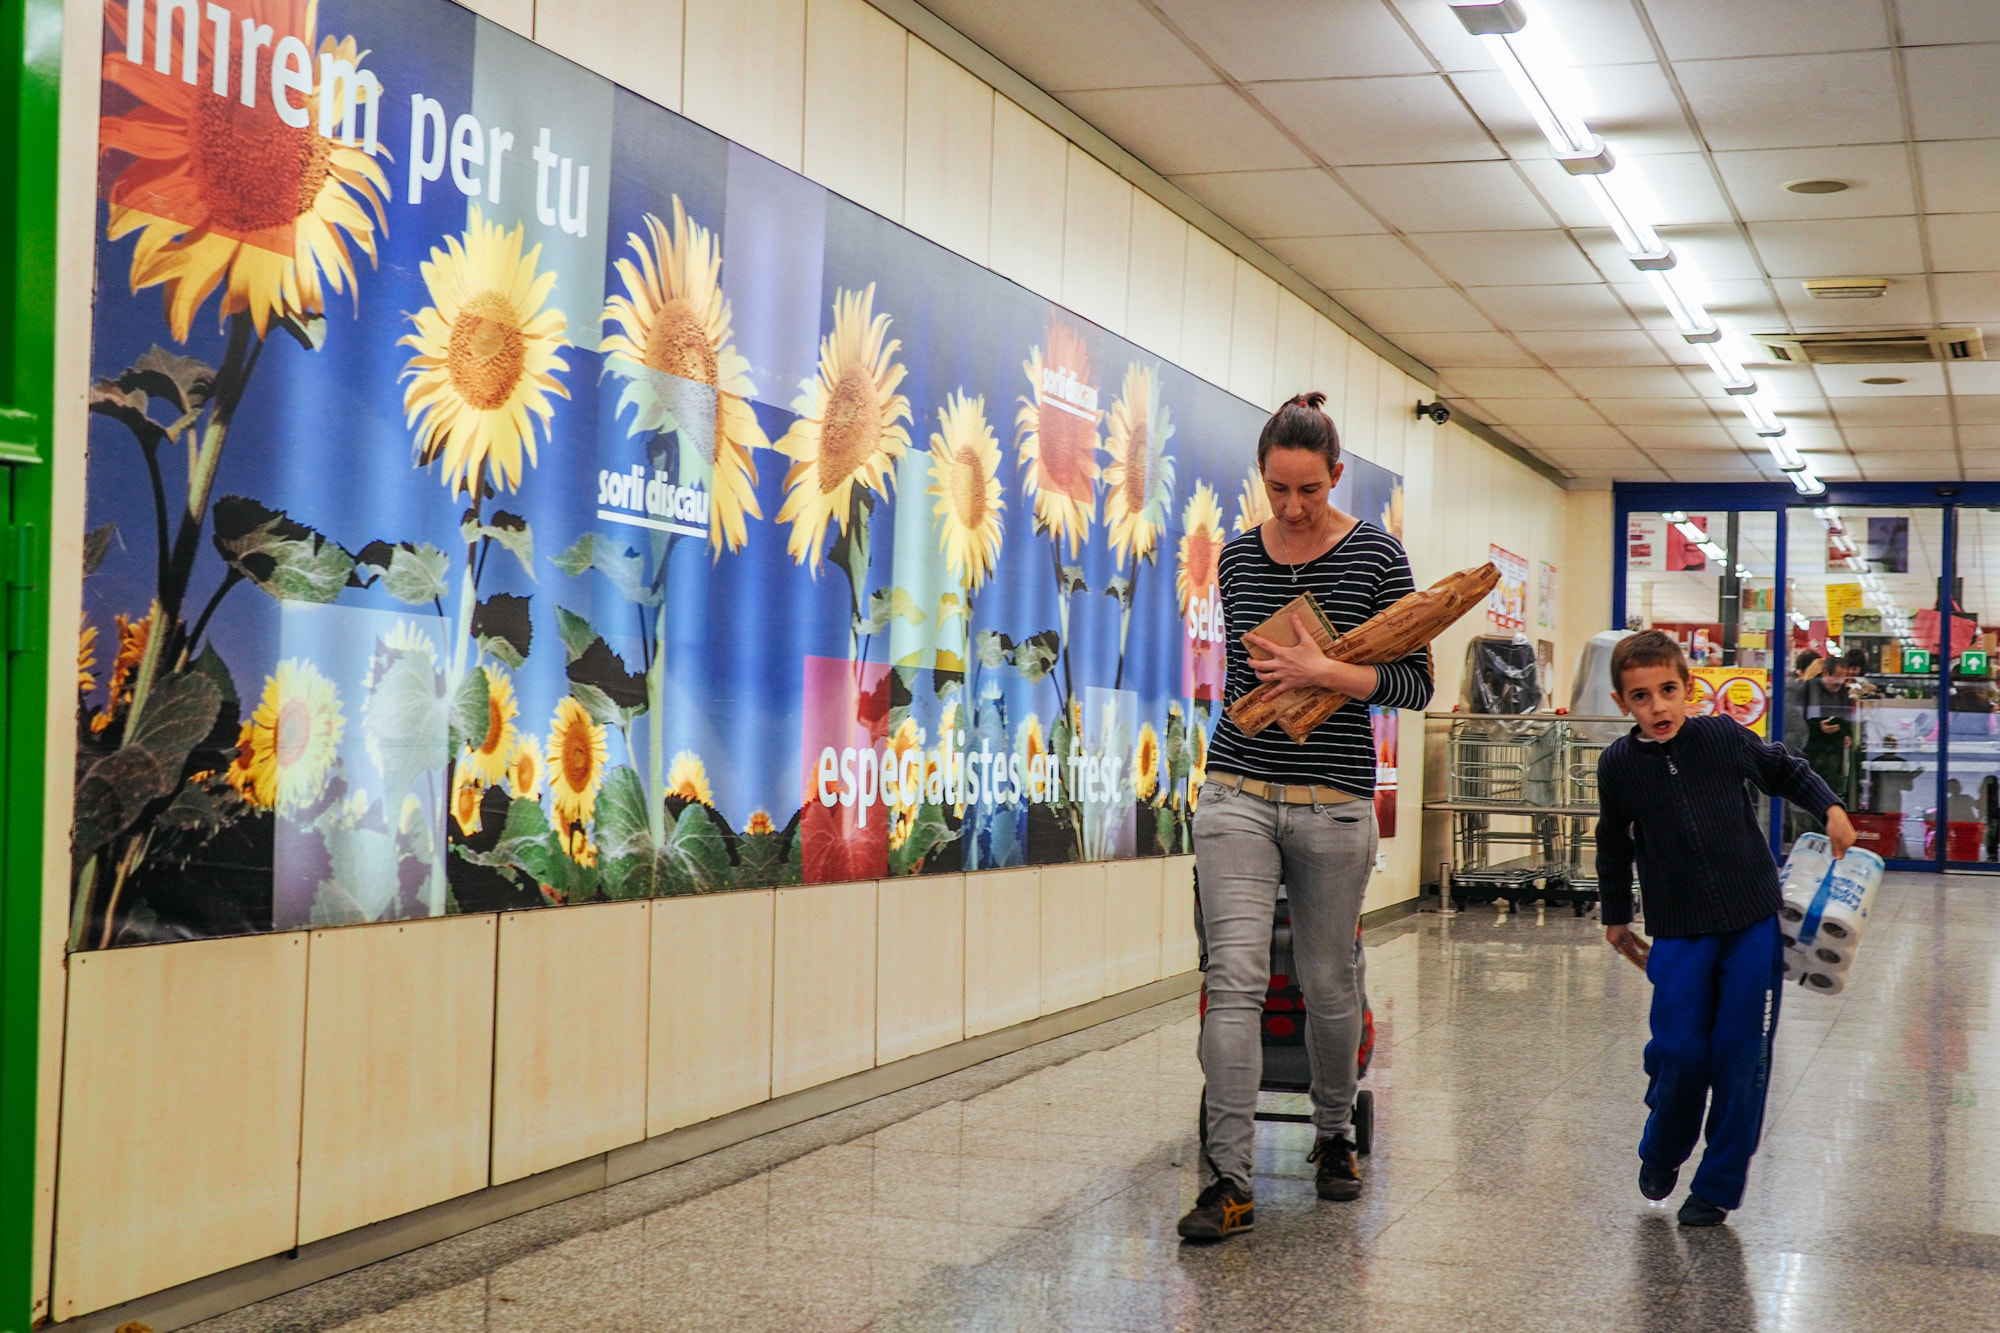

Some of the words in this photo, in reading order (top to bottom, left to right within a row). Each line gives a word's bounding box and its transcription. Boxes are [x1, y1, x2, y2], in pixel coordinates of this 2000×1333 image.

[408, 92, 514, 205] per
[532, 126, 590, 238] tu
[1043, 366, 1066, 398] sorli
[598, 464, 645, 511] sorli
[645, 470, 709, 524] discau
[818, 728, 1022, 829] especialistes
[1030, 751, 1060, 803] en
[1068, 736, 1123, 802] fresc
